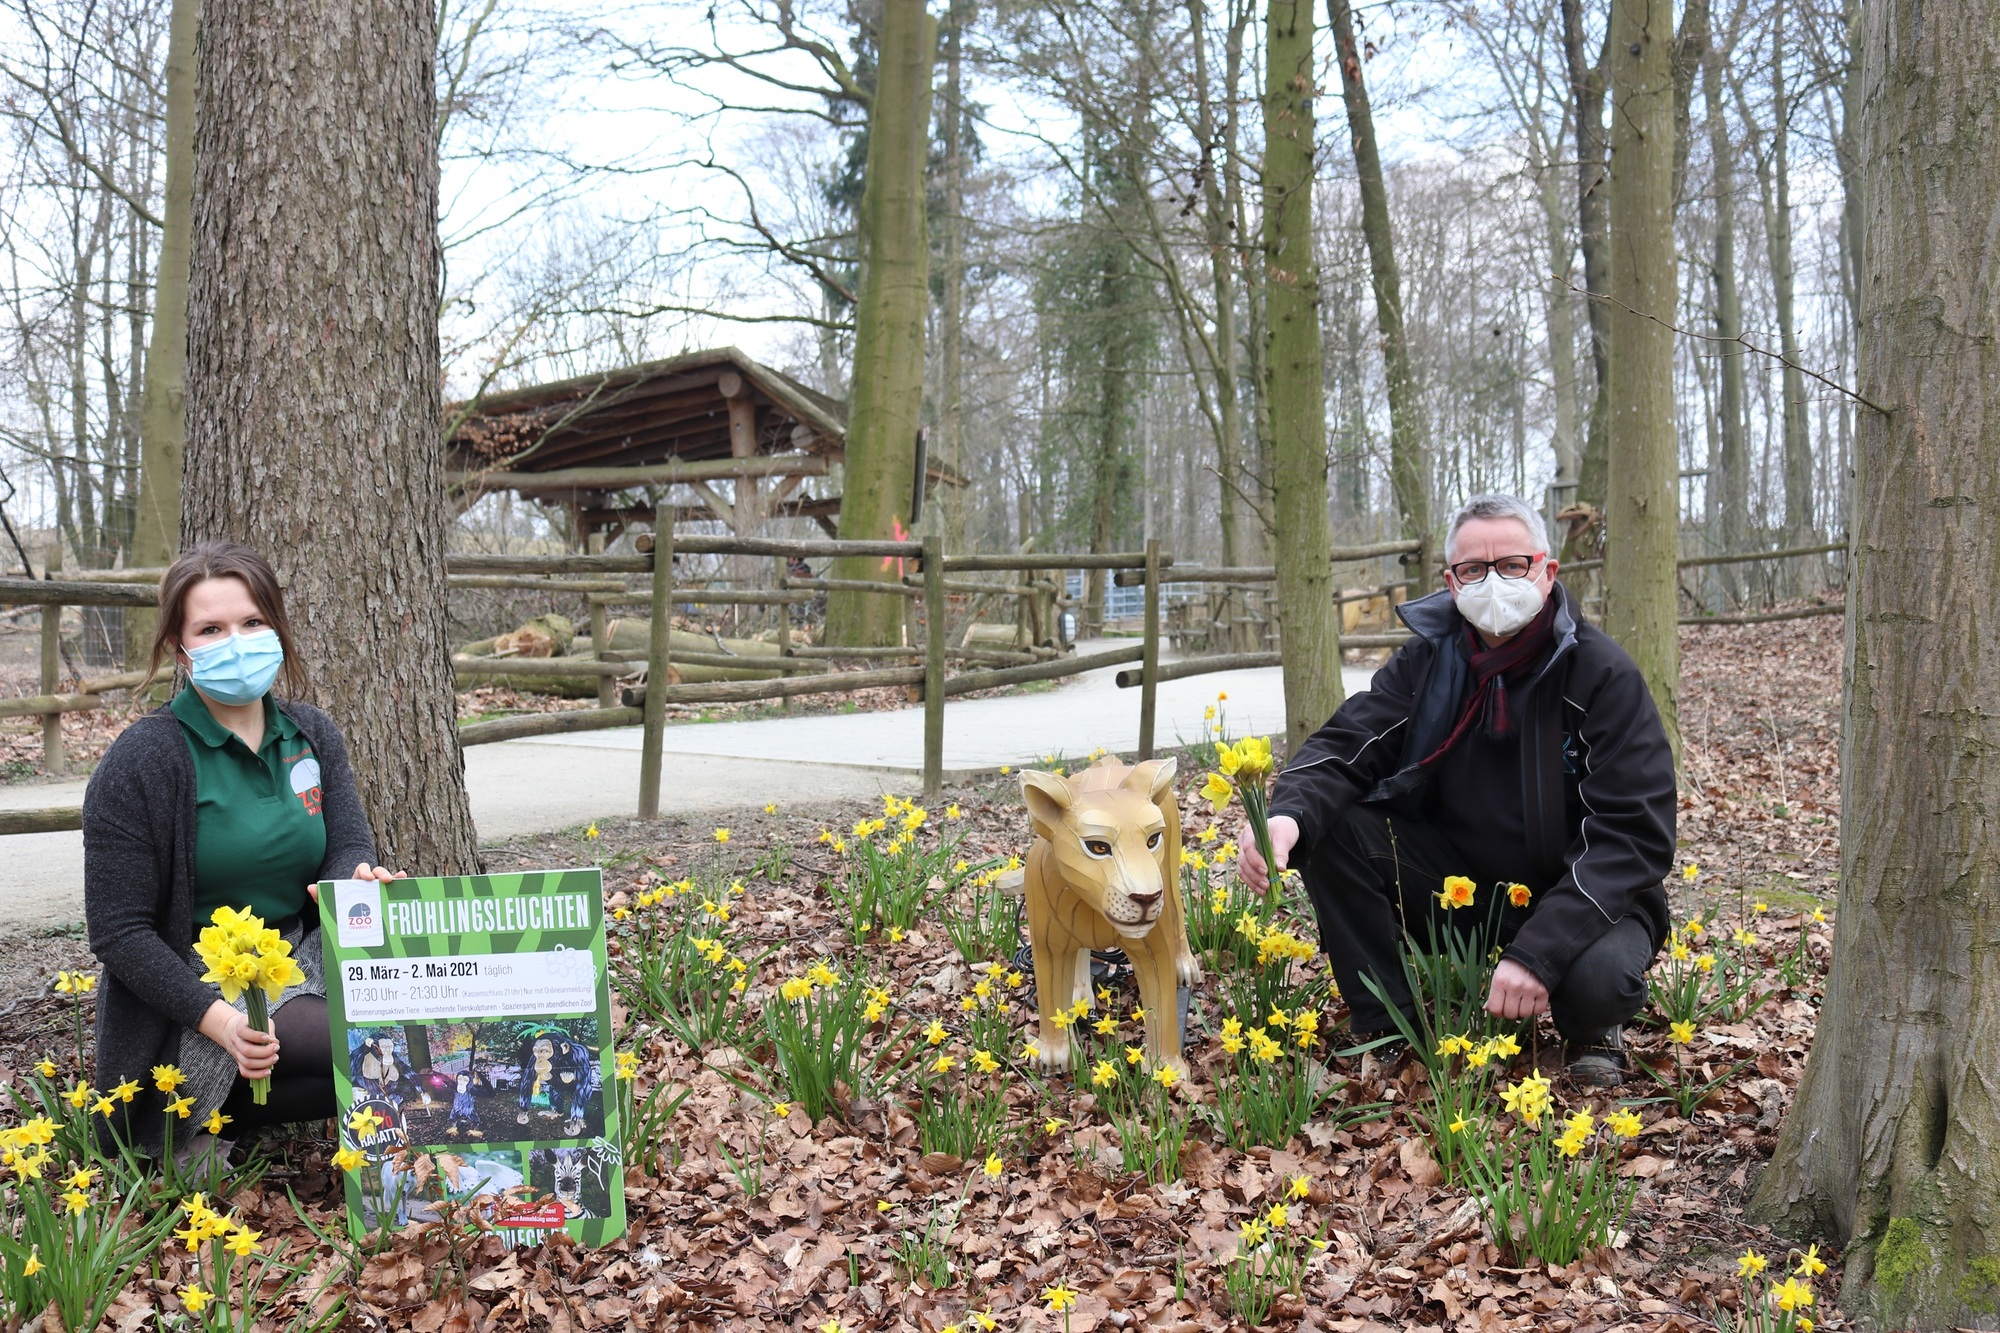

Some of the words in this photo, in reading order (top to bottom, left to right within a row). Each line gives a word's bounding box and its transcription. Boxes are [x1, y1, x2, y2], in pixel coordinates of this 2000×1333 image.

[297, 787, 322, 808] ZO
[349, 917, 372, 926] ZOO
[387, 894, 589, 936] FRÜHLINGSLEUCHTEN
[348, 966, 367, 981] 29.
[370, 965, 400, 980] März
[411, 964, 423, 979] 2.
[426, 963, 447, 978] Mai
[450, 961, 478, 977] 2021
[484, 964, 513, 977] täglich
[350, 988, 378, 1002] 17:30
[380, 987, 399, 1001] Uhr
[410, 985, 438, 1000] 21:30
[441, 985, 459, 999] Uhr
[534, 987, 544, 995] mit
[351, 1007, 405, 1017] dämmerungsaktive
[406, 1006, 420, 1014] Tiere
[424, 1005, 455, 1014] leuchtende
[457, 1003, 497, 1013] Tierskulpturen
[502, 1002, 537, 1011] Spaziergang
[537, 1001, 544, 1009] im
[545, 999, 579, 1008] abendlichen
[580, 999, 592, 1007] Zoo!
